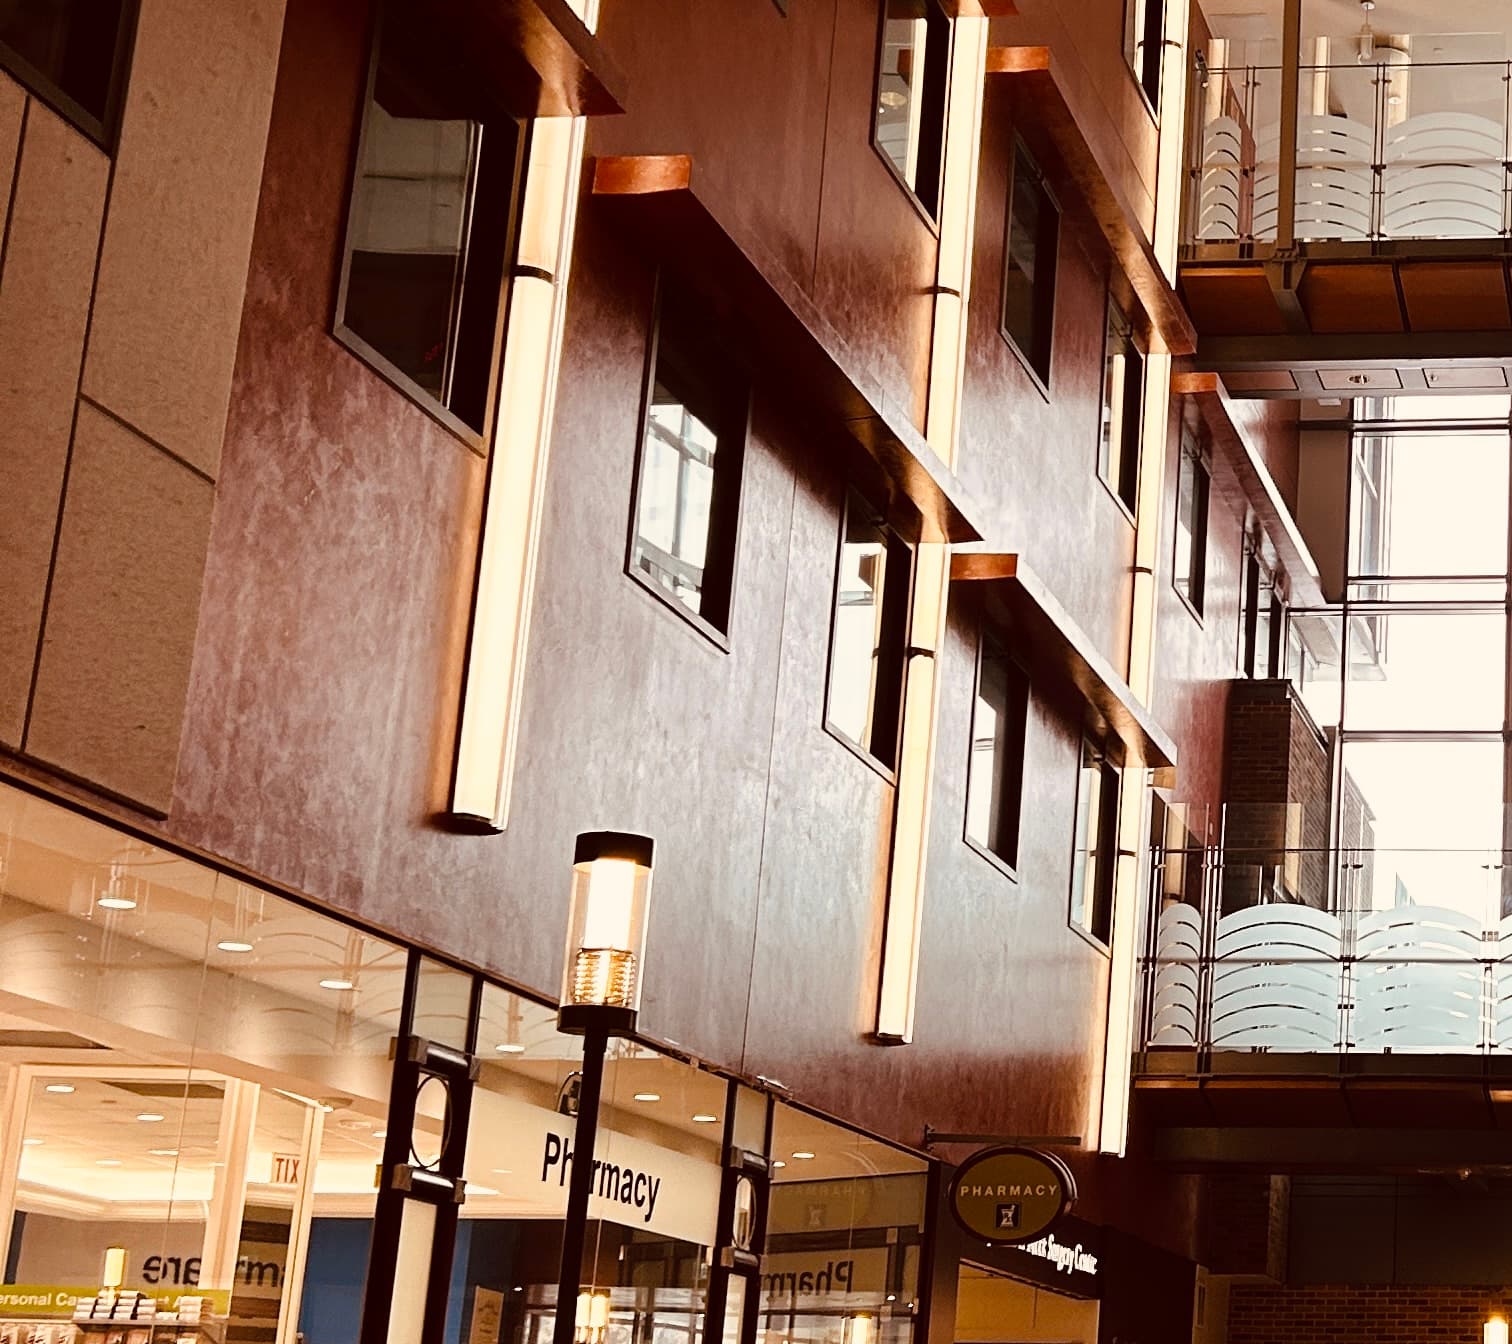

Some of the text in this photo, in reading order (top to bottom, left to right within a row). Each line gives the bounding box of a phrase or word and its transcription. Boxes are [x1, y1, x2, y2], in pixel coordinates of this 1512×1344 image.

[541, 1132, 661, 1223] Phrmacy
[960, 1185, 1058, 1197] PHARMACY
[0, 1292, 52, 1306] ersonal
